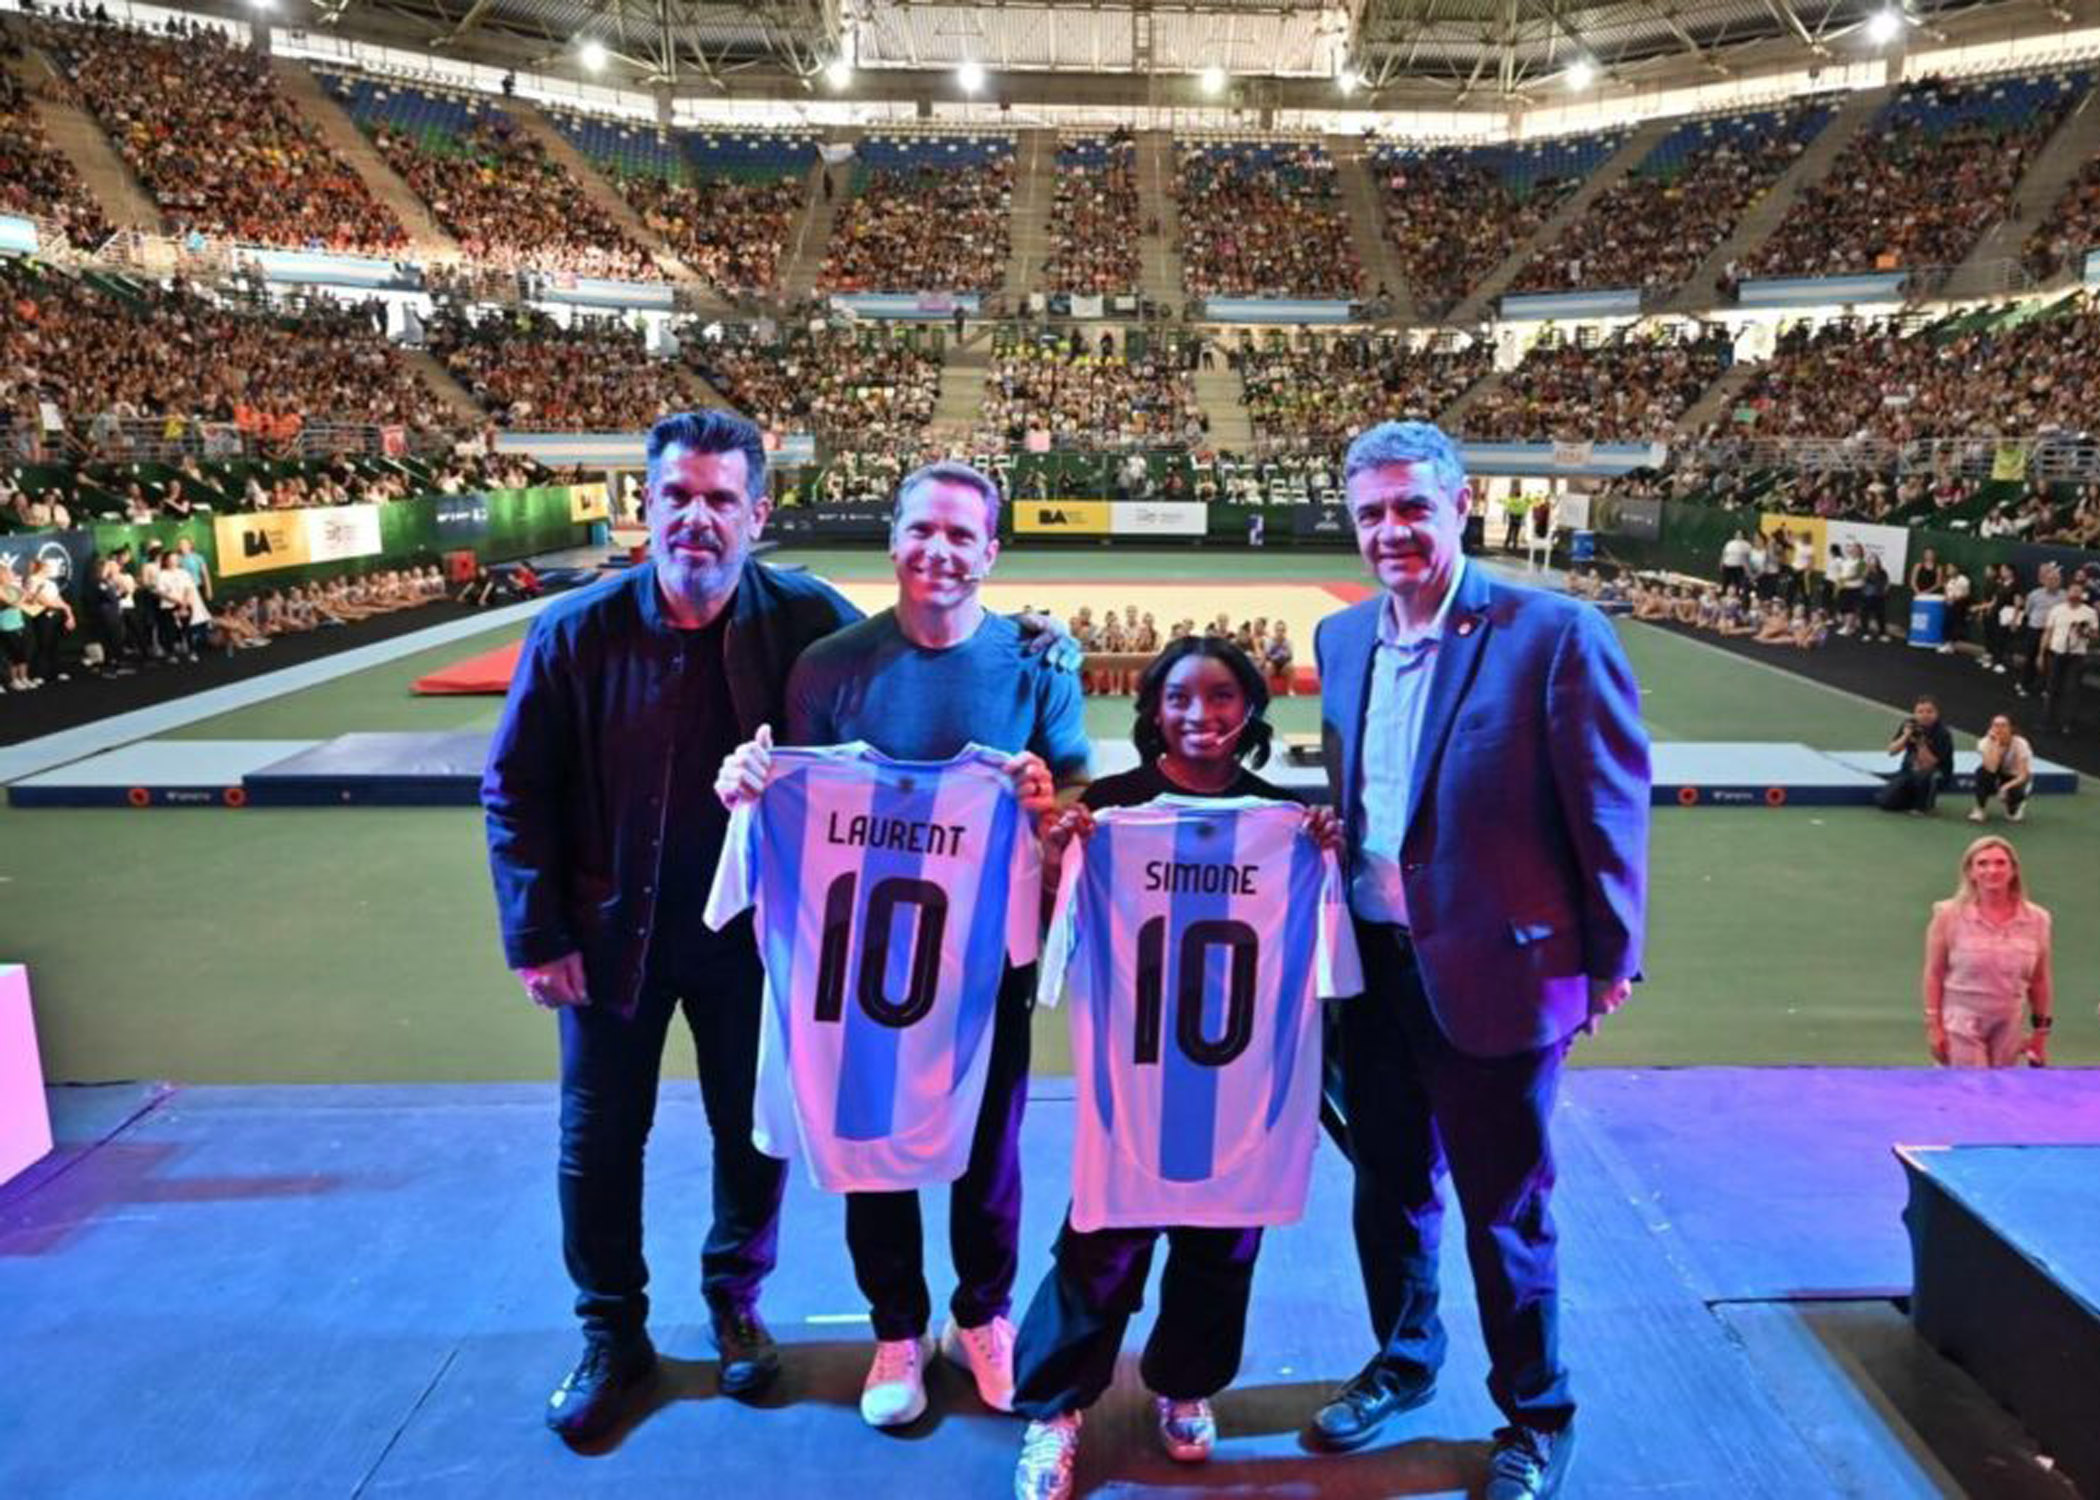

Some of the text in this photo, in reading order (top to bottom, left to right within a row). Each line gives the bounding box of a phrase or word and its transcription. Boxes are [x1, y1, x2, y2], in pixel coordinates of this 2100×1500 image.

[1038, 510, 1067, 525] BA
[243, 528, 273, 558] BA
[827, 811, 967, 857] LAURENT
[1144, 860, 1260, 895] SIMONE
[813, 871, 948, 1028] 10
[1133, 916, 1259, 1067] 10
